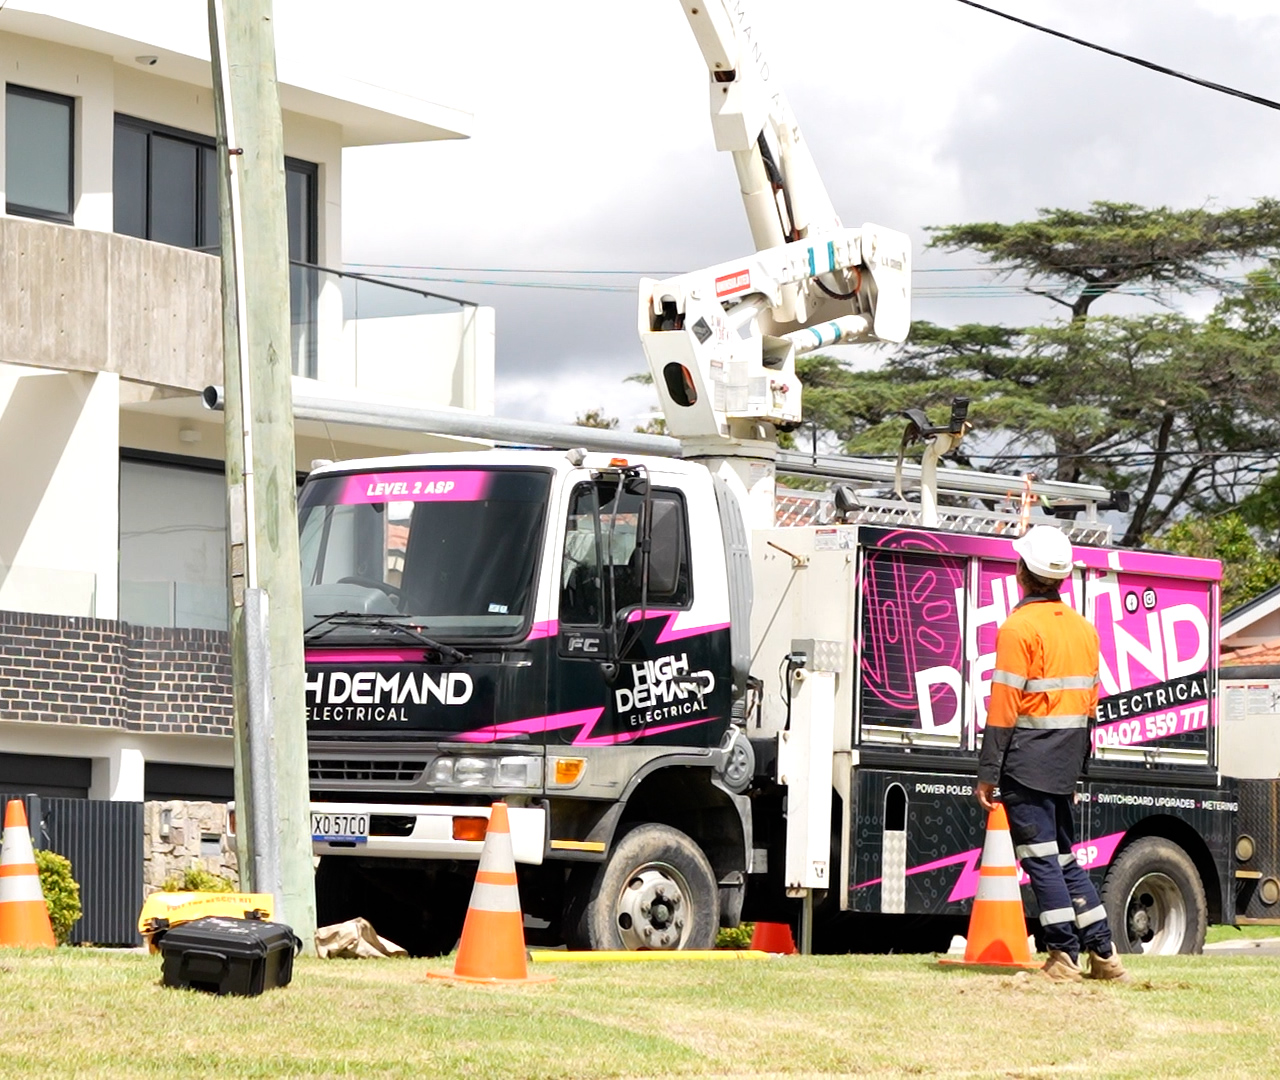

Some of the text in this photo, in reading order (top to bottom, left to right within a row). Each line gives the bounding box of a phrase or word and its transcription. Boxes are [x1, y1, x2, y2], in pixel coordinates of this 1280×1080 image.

[366, 481, 455, 496] LEVEL 2 ASP
[632, 653, 689, 687] HIGH
[328, 672, 473, 705] DEMAND
[615, 670, 715, 713] DEMAND
[1096, 678, 1217, 723] ELECTRICAL
[630, 700, 708, 726] ELECTRICAL
[1091, 704, 1208, 747] 0402 559 777
[915, 783, 973, 796] POWER POLES
[1097, 793, 1154, 806] SWITCHBOARD
[1155, 797, 1195, 809] UPGRADES
[1201, 800, 1239, 812] METERING
[1074, 845, 1098, 867] SP
